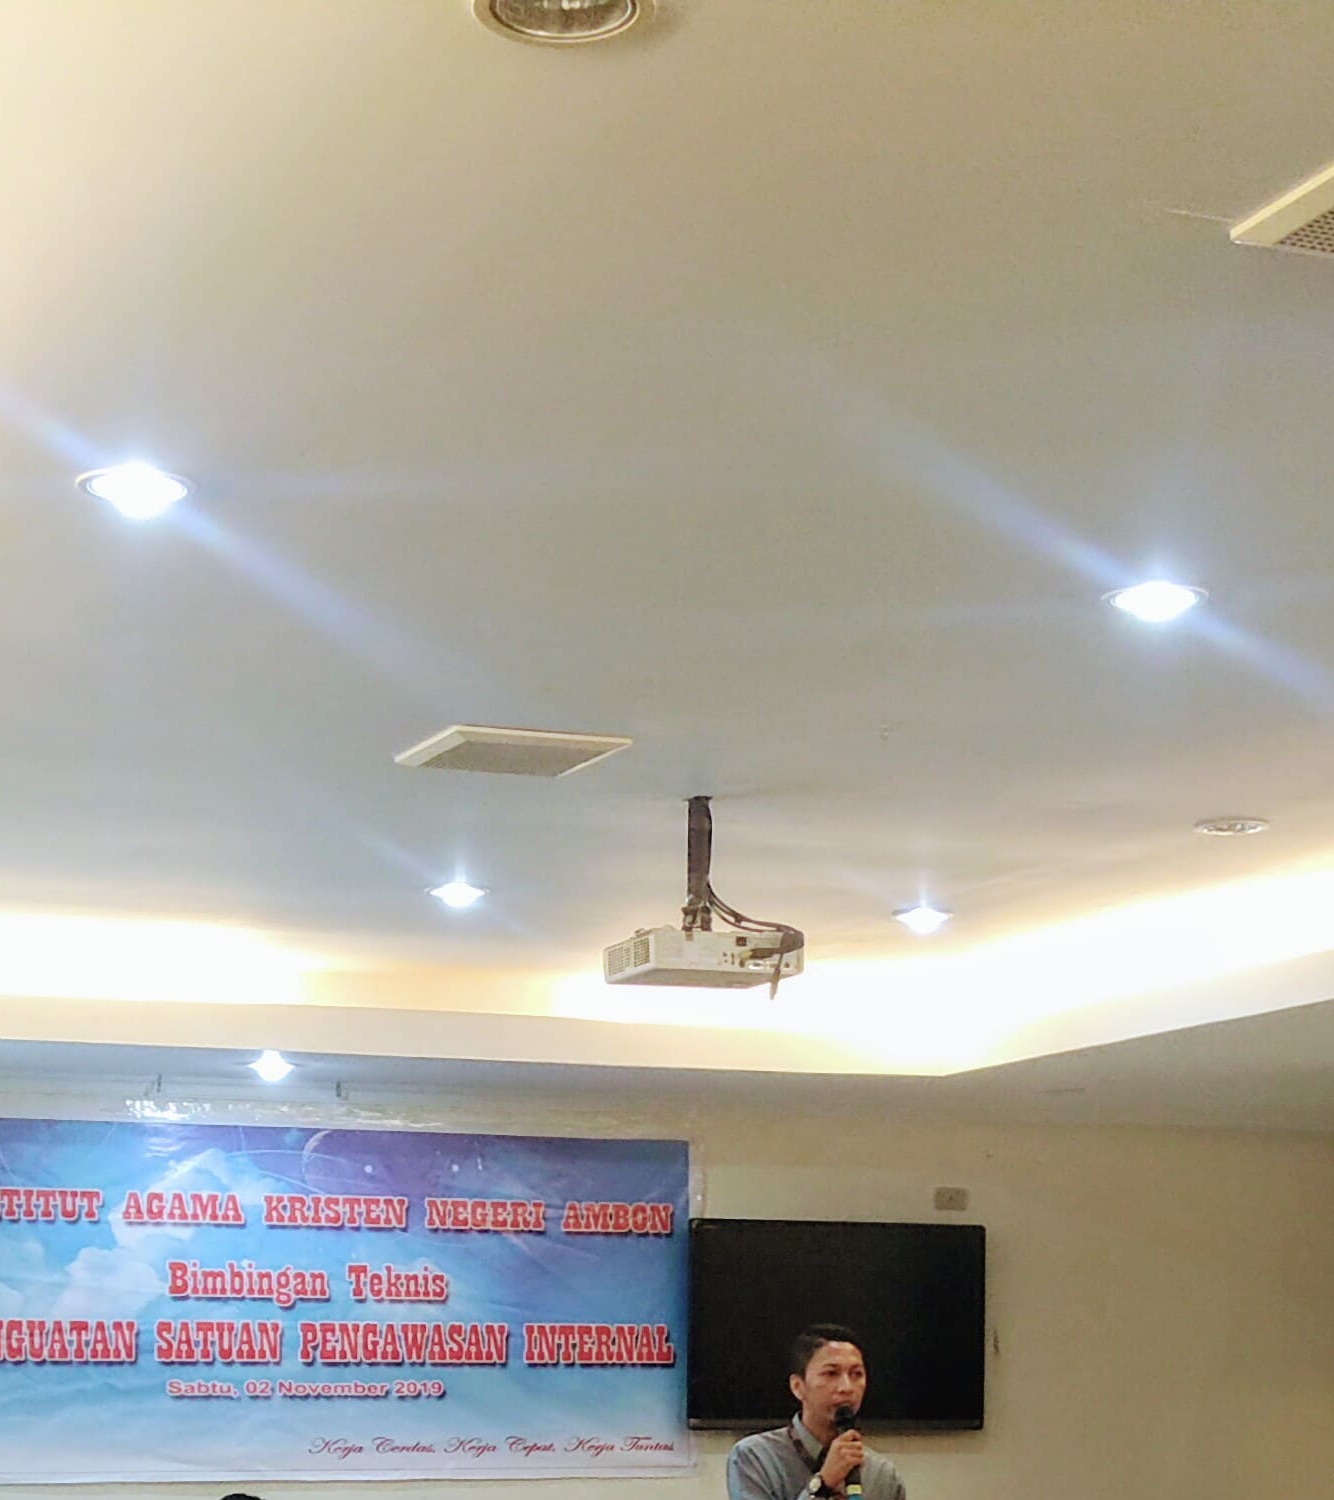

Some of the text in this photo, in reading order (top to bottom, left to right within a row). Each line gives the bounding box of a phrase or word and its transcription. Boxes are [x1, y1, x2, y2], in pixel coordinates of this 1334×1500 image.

[123, 1192, 245, 1224] AGAMA
[264, 1195, 408, 1228] KRISTEN
[426, 1199, 546, 1231] NEGERI
[561, 1203, 672, 1234] AMBON
[168, 1260, 449, 1307] Bimbingan Teknis
[155, 1321, 282, 1362] SATUAN
[299, 1322, 509, 1363] PENGAWASAN
[524, 1323, 674, 1364] INTERNAL
[168, 1380, 444, 1397] Sabtu, 02 November 2019
[308, 1436, 364, 1460] Kerja
[443, 1436, 498, 1458] Kerja
[564, 1436, 616, 1457] Kerja
